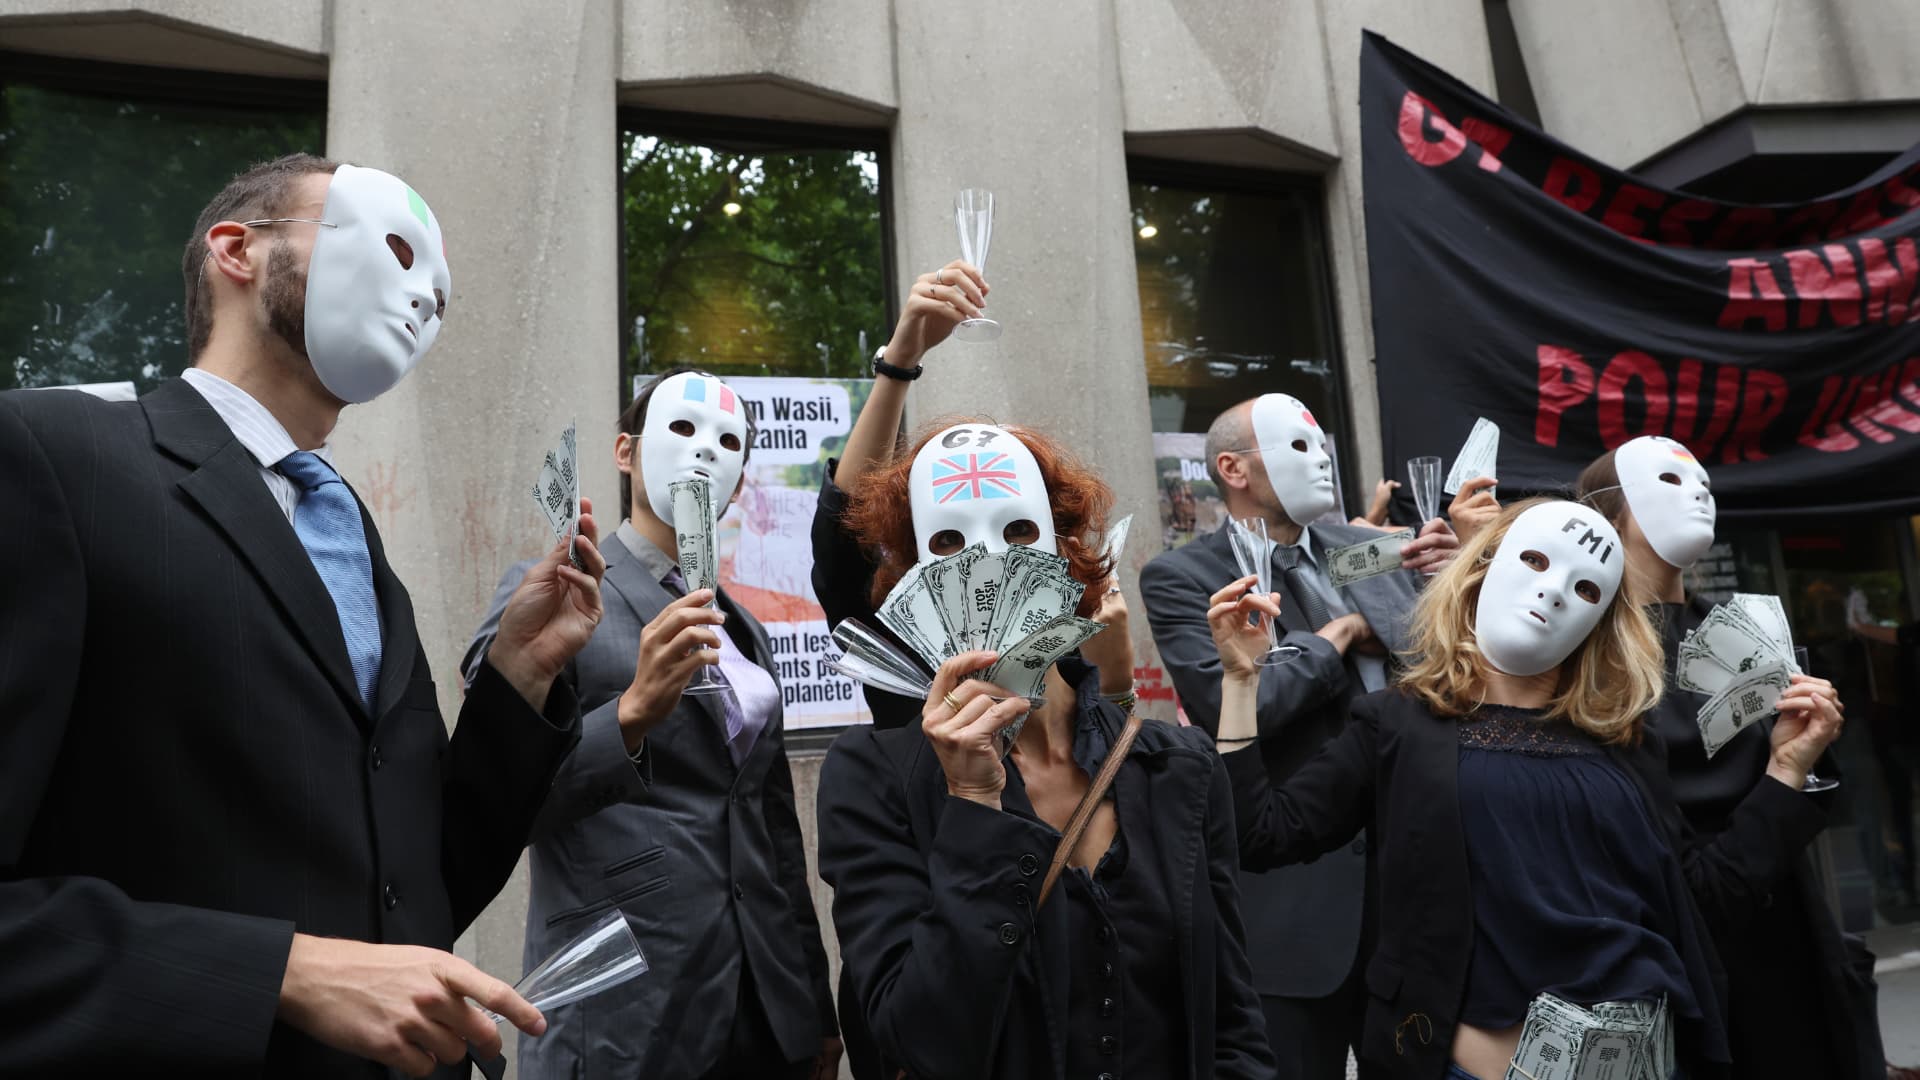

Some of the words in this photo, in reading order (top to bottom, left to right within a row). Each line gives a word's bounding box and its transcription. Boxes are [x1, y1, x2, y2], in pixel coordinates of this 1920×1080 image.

[1398, 90, 1512, 173] G7
[1717, 237, 1920, 332] ANN
[771, 395, 839, 425] Wasii,
[1535, 344, 1790, 465] POUR
[941, 428, 1000, 449] G7
[690, 552, 698, 570] STOP
[975, 588, 987, 612] STOP
[1020, 609, 1035, 634] STOP
[1029, 608, 1048, 634] OSSIL
[803, 632, 831, 653] les
[1741, 691, 1756, 703] STOP
